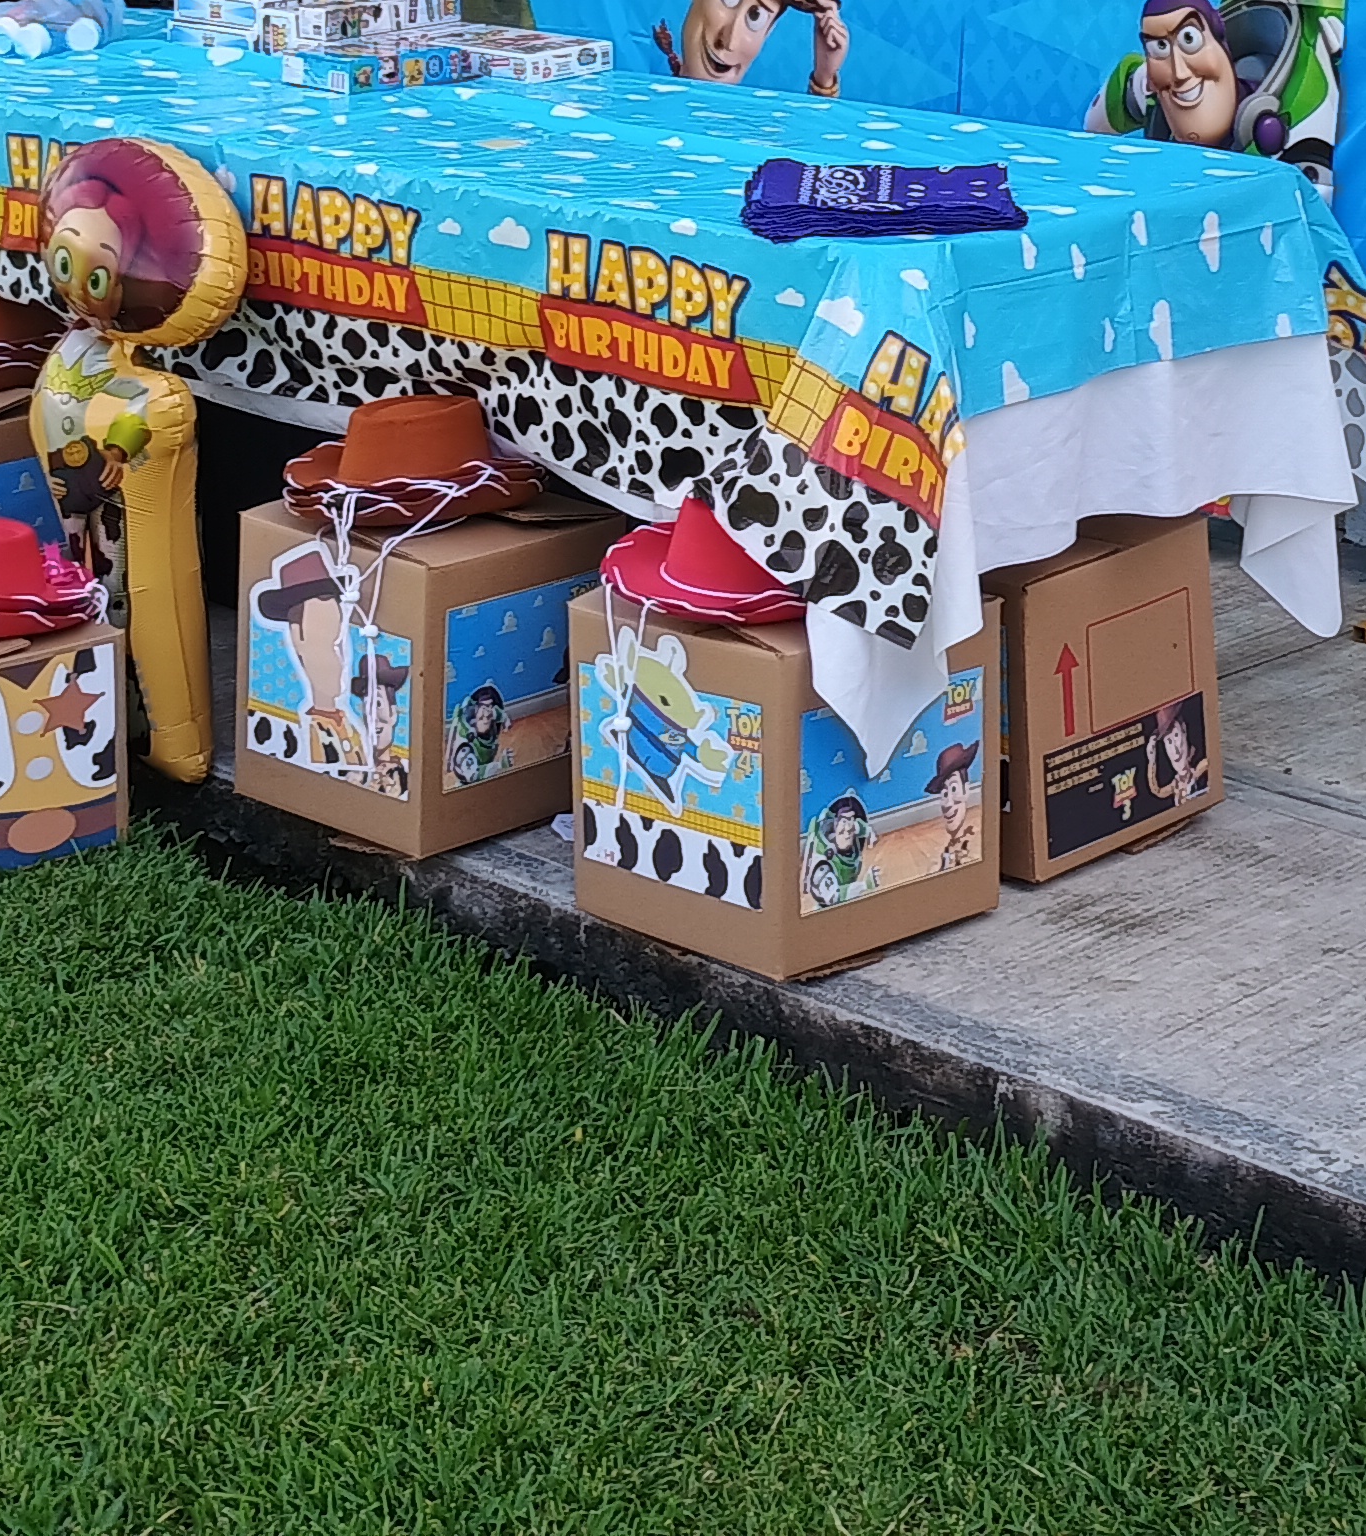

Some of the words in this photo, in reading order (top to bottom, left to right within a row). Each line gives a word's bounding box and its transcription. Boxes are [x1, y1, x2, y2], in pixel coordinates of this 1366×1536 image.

[249, 173, 422, 268] HAPPY
[248, 248, 410, 314] BIRTHDAY
[544, 229, 752, 342] HAPPY
[544, 308, 736, 390] BIRTHDAY
[724, 707, 762, 738] TOY
[946, 677, 978, 705] TOY
